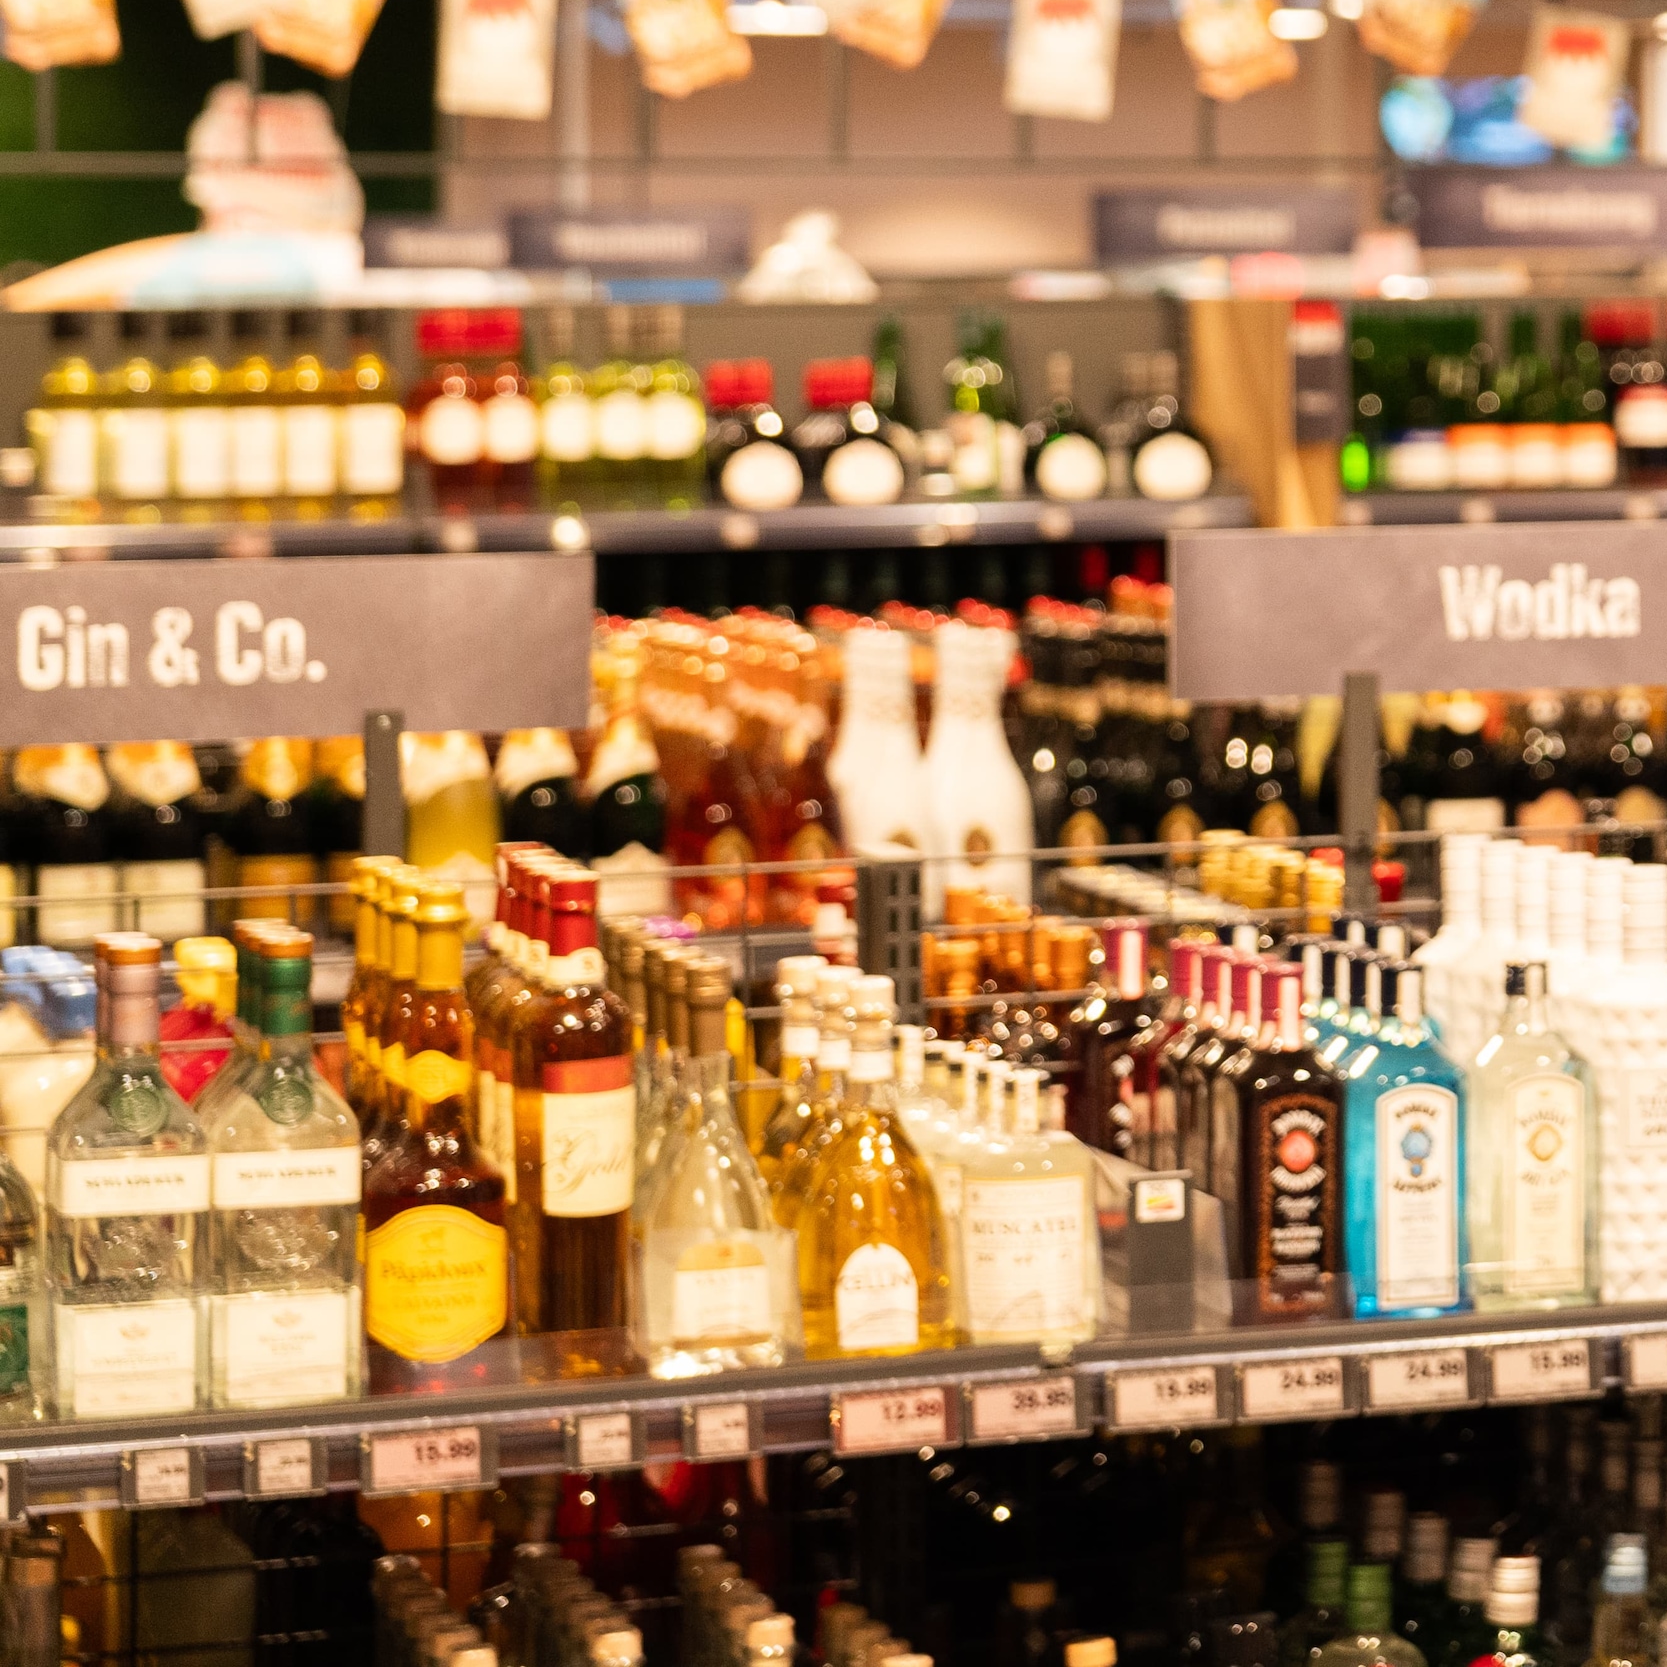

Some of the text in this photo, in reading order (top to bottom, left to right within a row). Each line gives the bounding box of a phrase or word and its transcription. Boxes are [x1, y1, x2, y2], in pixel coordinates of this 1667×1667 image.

[1438, 563, 1642, 641] Wodka
[17, 600, 328, 691] Gin & Co.
